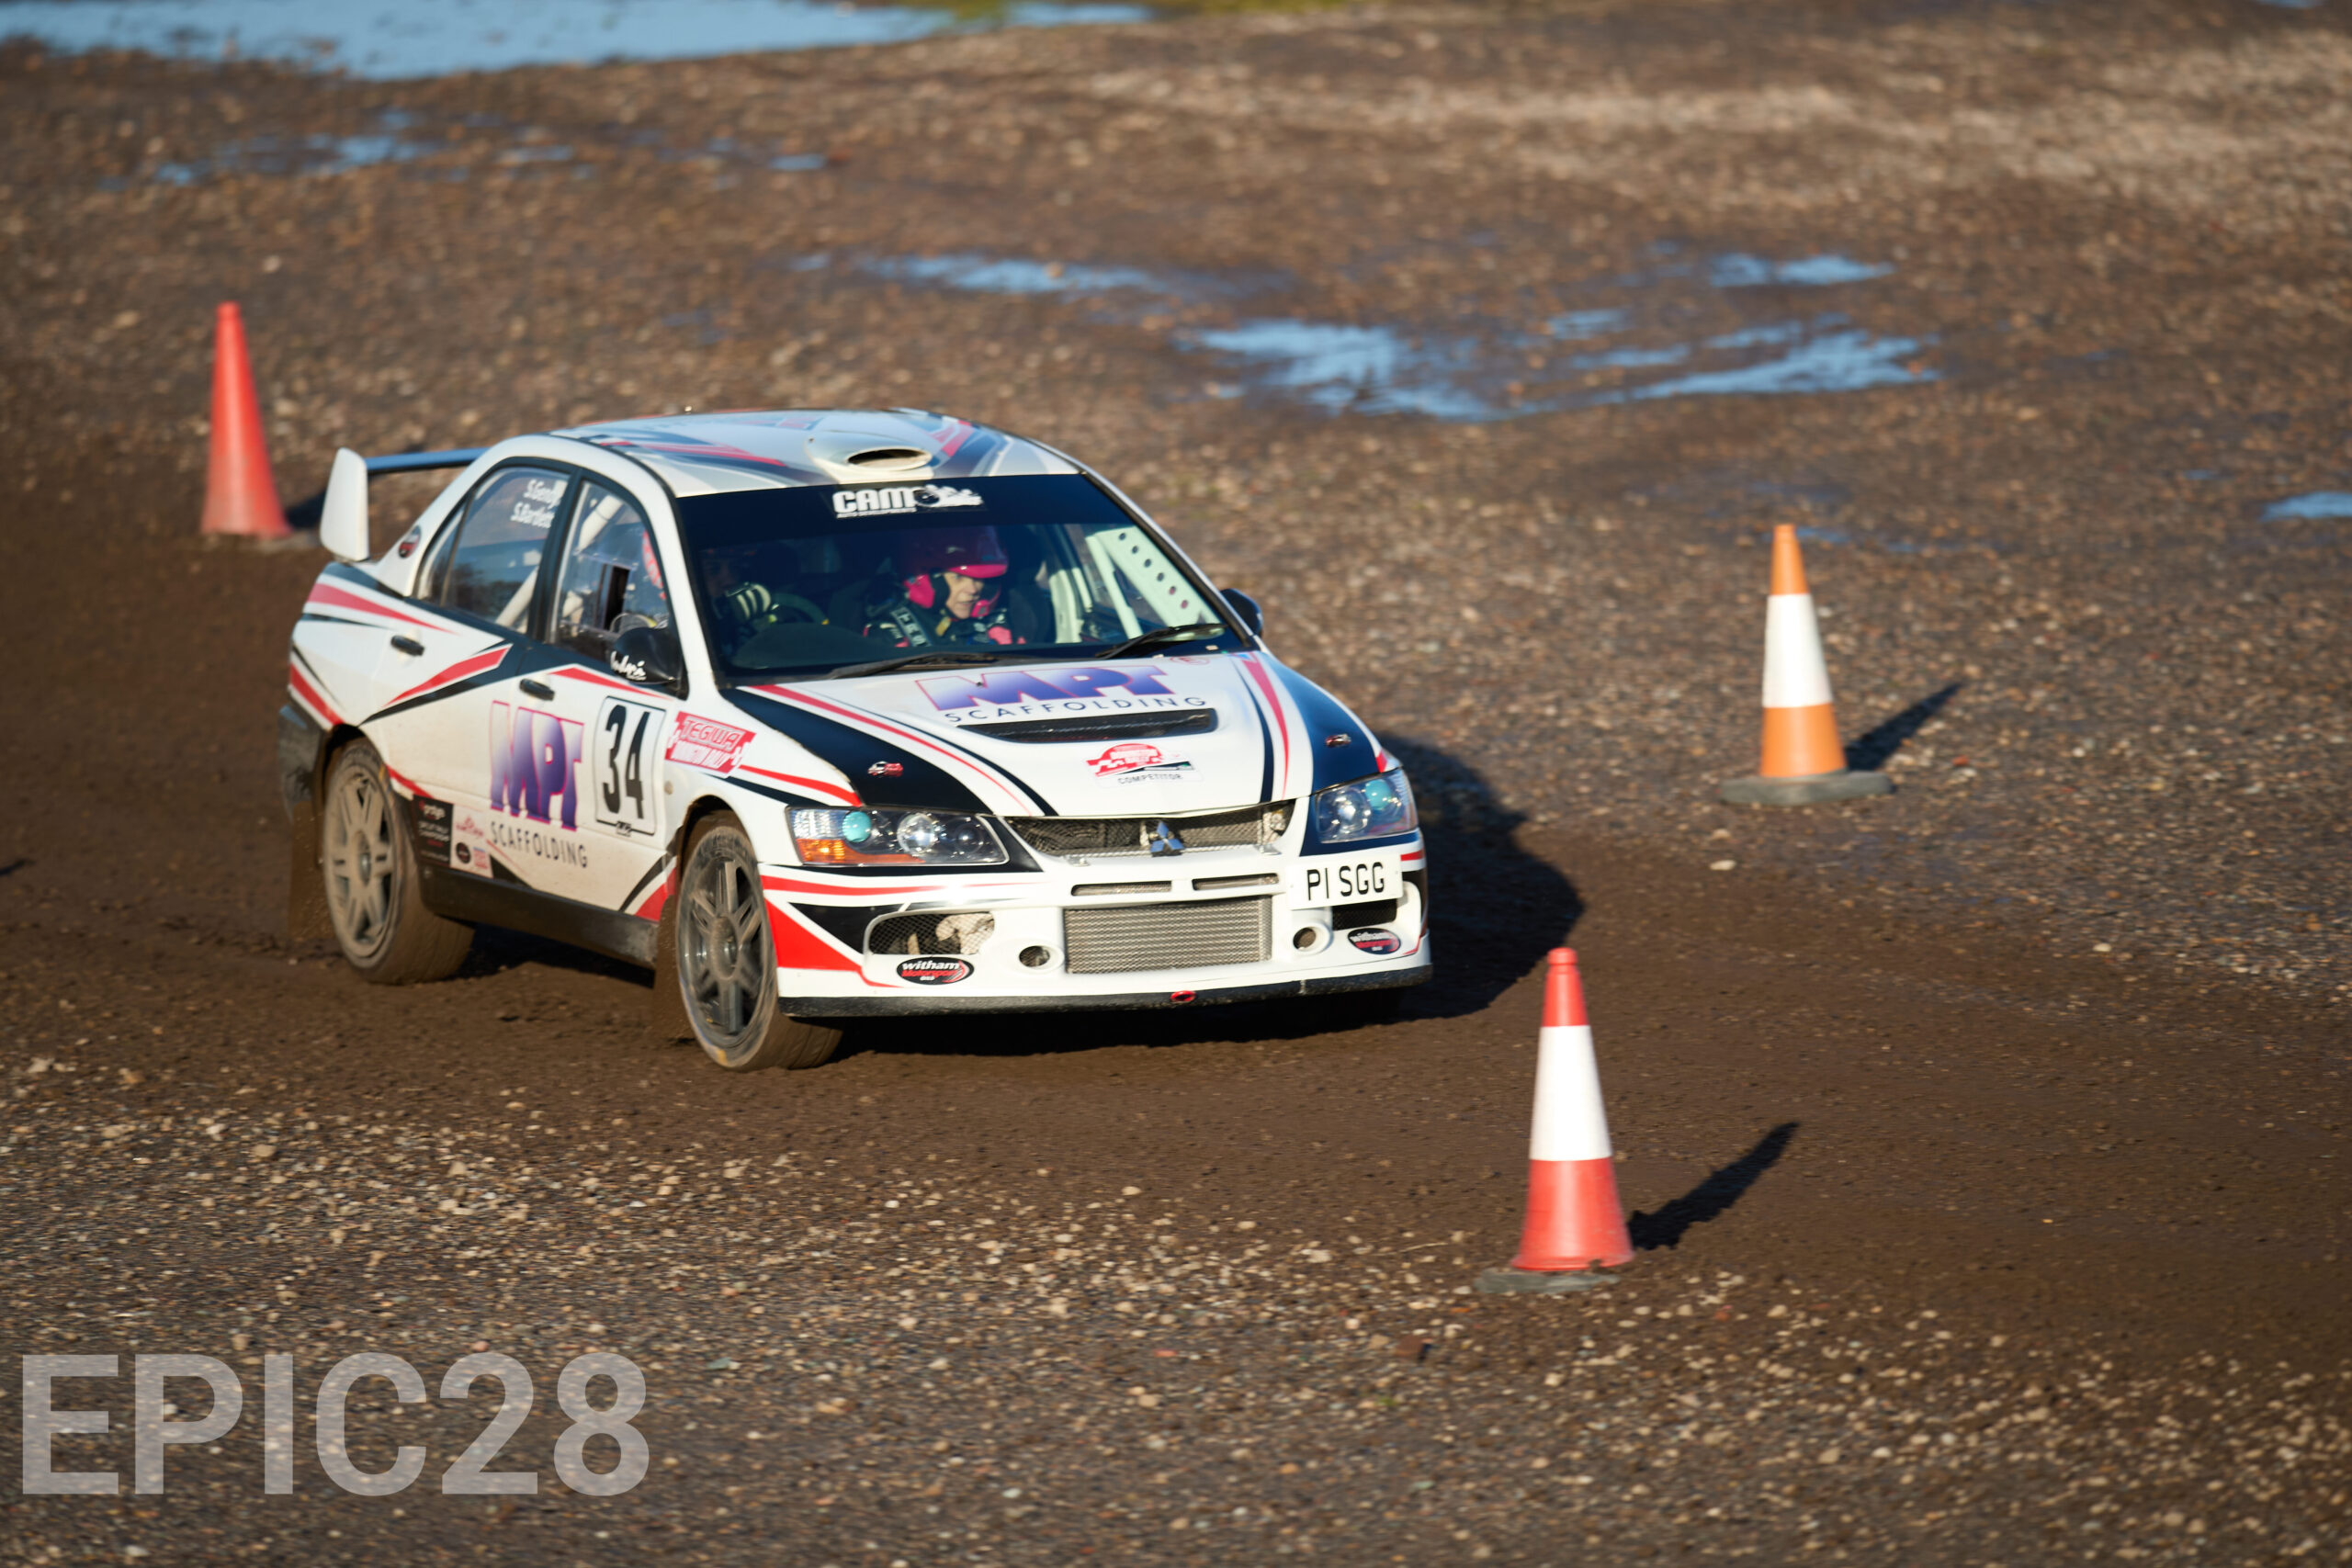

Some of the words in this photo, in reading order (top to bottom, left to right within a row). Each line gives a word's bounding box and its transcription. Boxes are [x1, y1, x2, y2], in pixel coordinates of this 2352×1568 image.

[944, 696, 1207, 723] SCAFFOLDING
[603, 705, 650, 819] 34
[1117, 773, 1182, 784] COMPETITOR
[491, 821, 588, 868] SCAFFOLDING
